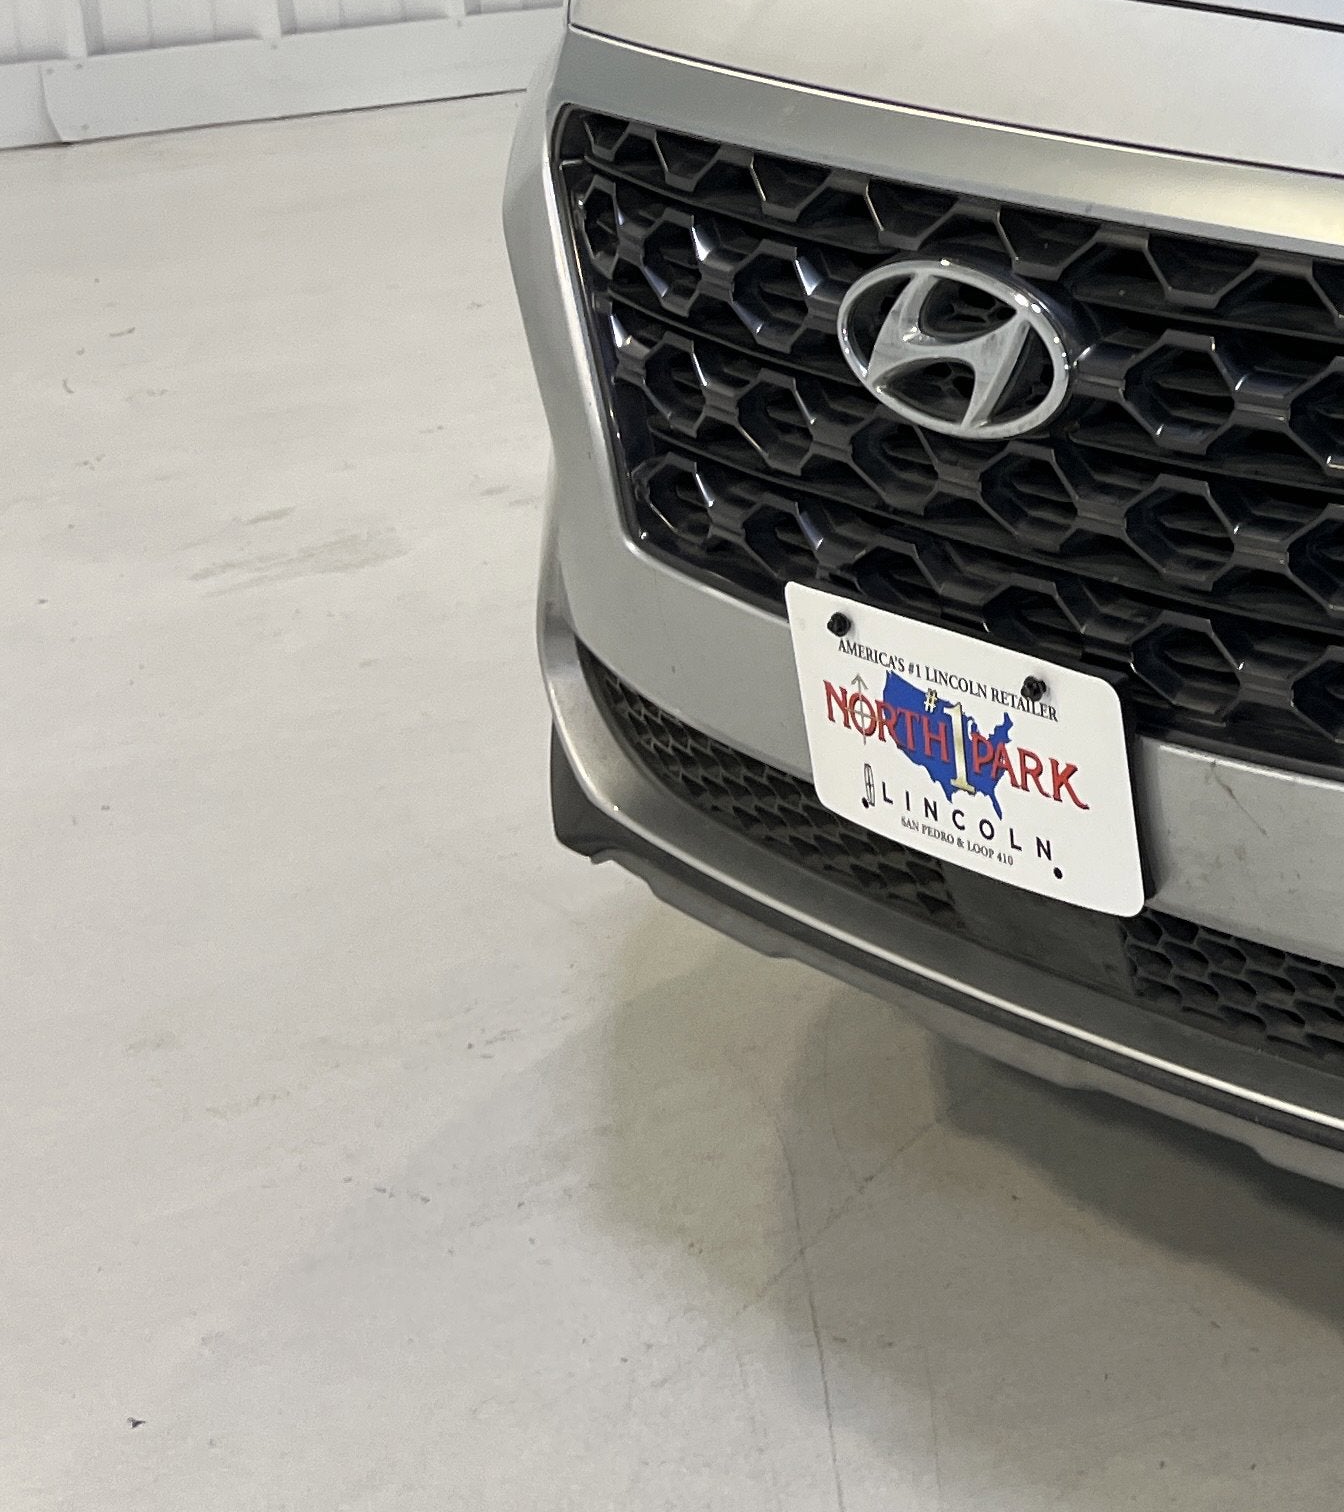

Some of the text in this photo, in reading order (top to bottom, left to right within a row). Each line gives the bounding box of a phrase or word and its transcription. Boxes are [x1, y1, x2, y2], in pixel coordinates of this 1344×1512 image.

[837, 638, 1059, 723] AMERICA'S #1 LINCOLN RETAILER
[822, 678, 1090, 811] NORTH PARK
[881, 781, 1052, 861] LINCOLN
[901, 815, 920, 832] SAN
[921, 824, 955, 845] PEDRO
[956, 837, 965, 850] &
[967, 840, 995, 859] LOOP
